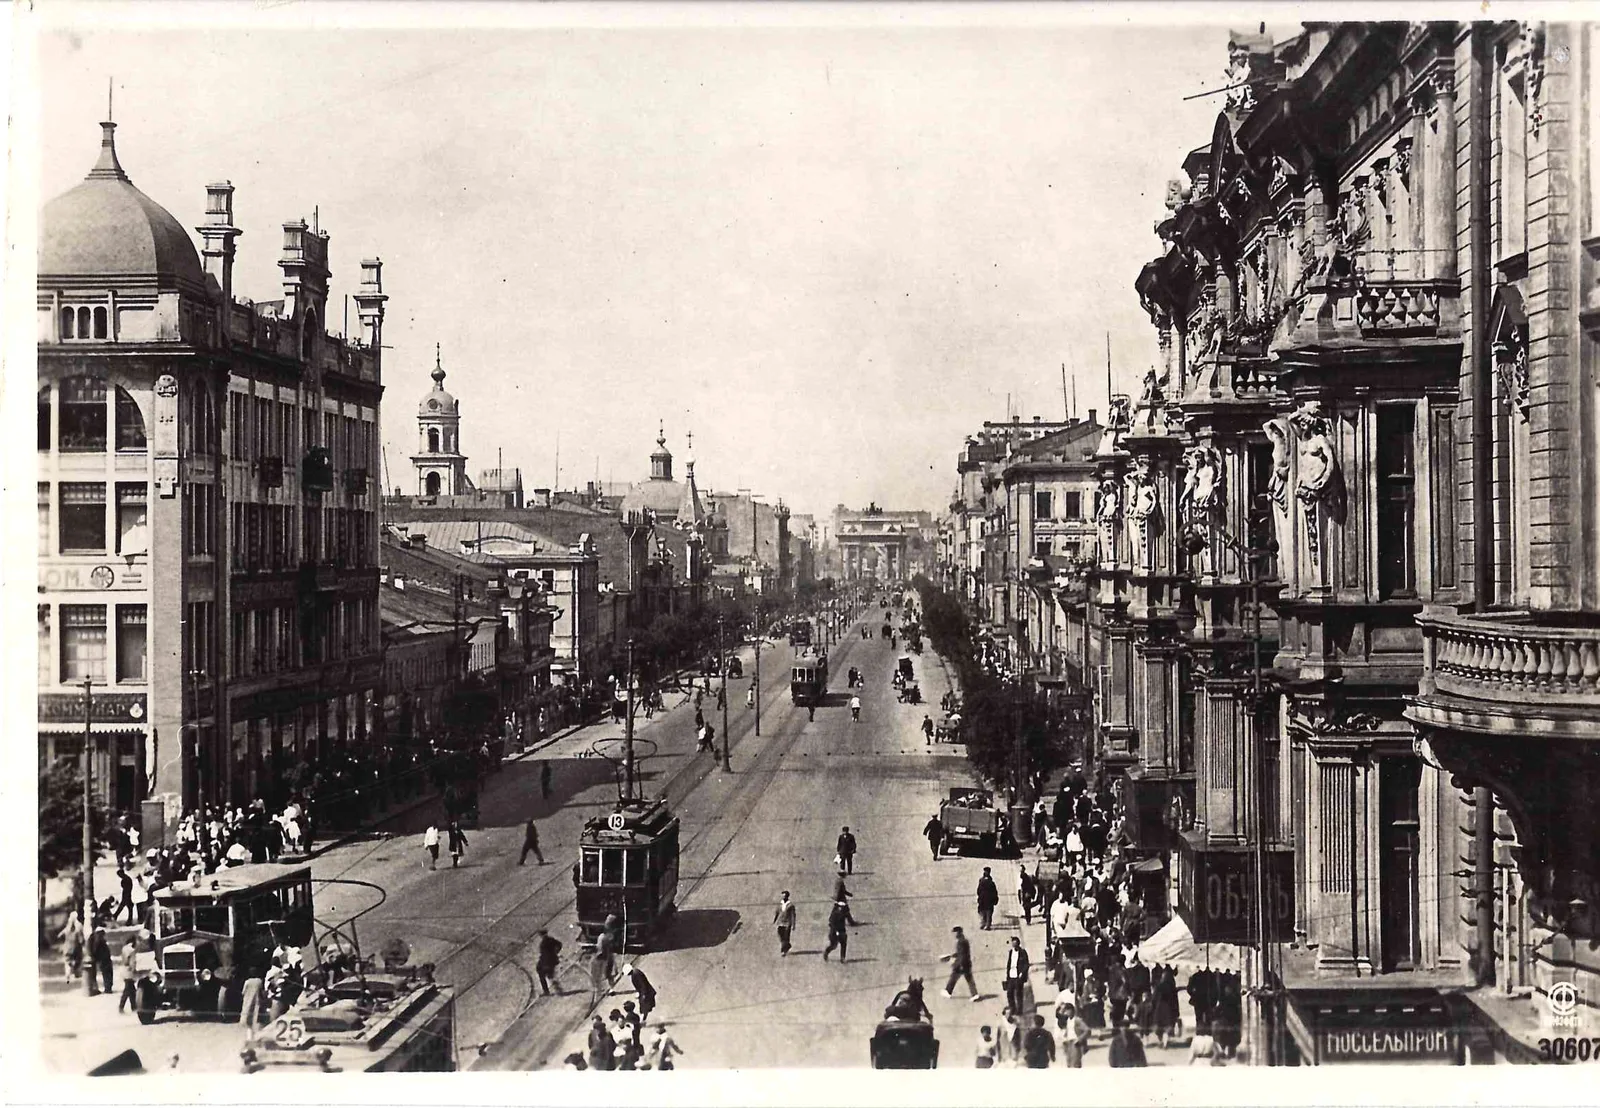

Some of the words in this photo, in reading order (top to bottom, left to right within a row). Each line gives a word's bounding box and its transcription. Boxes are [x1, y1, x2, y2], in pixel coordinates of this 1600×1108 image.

[610, 816, 623, 829] 13
[275, 1019, 303, 1042] 25
[1327, 1029, 1448, 1053] МОССЕЛЬПРОМ
